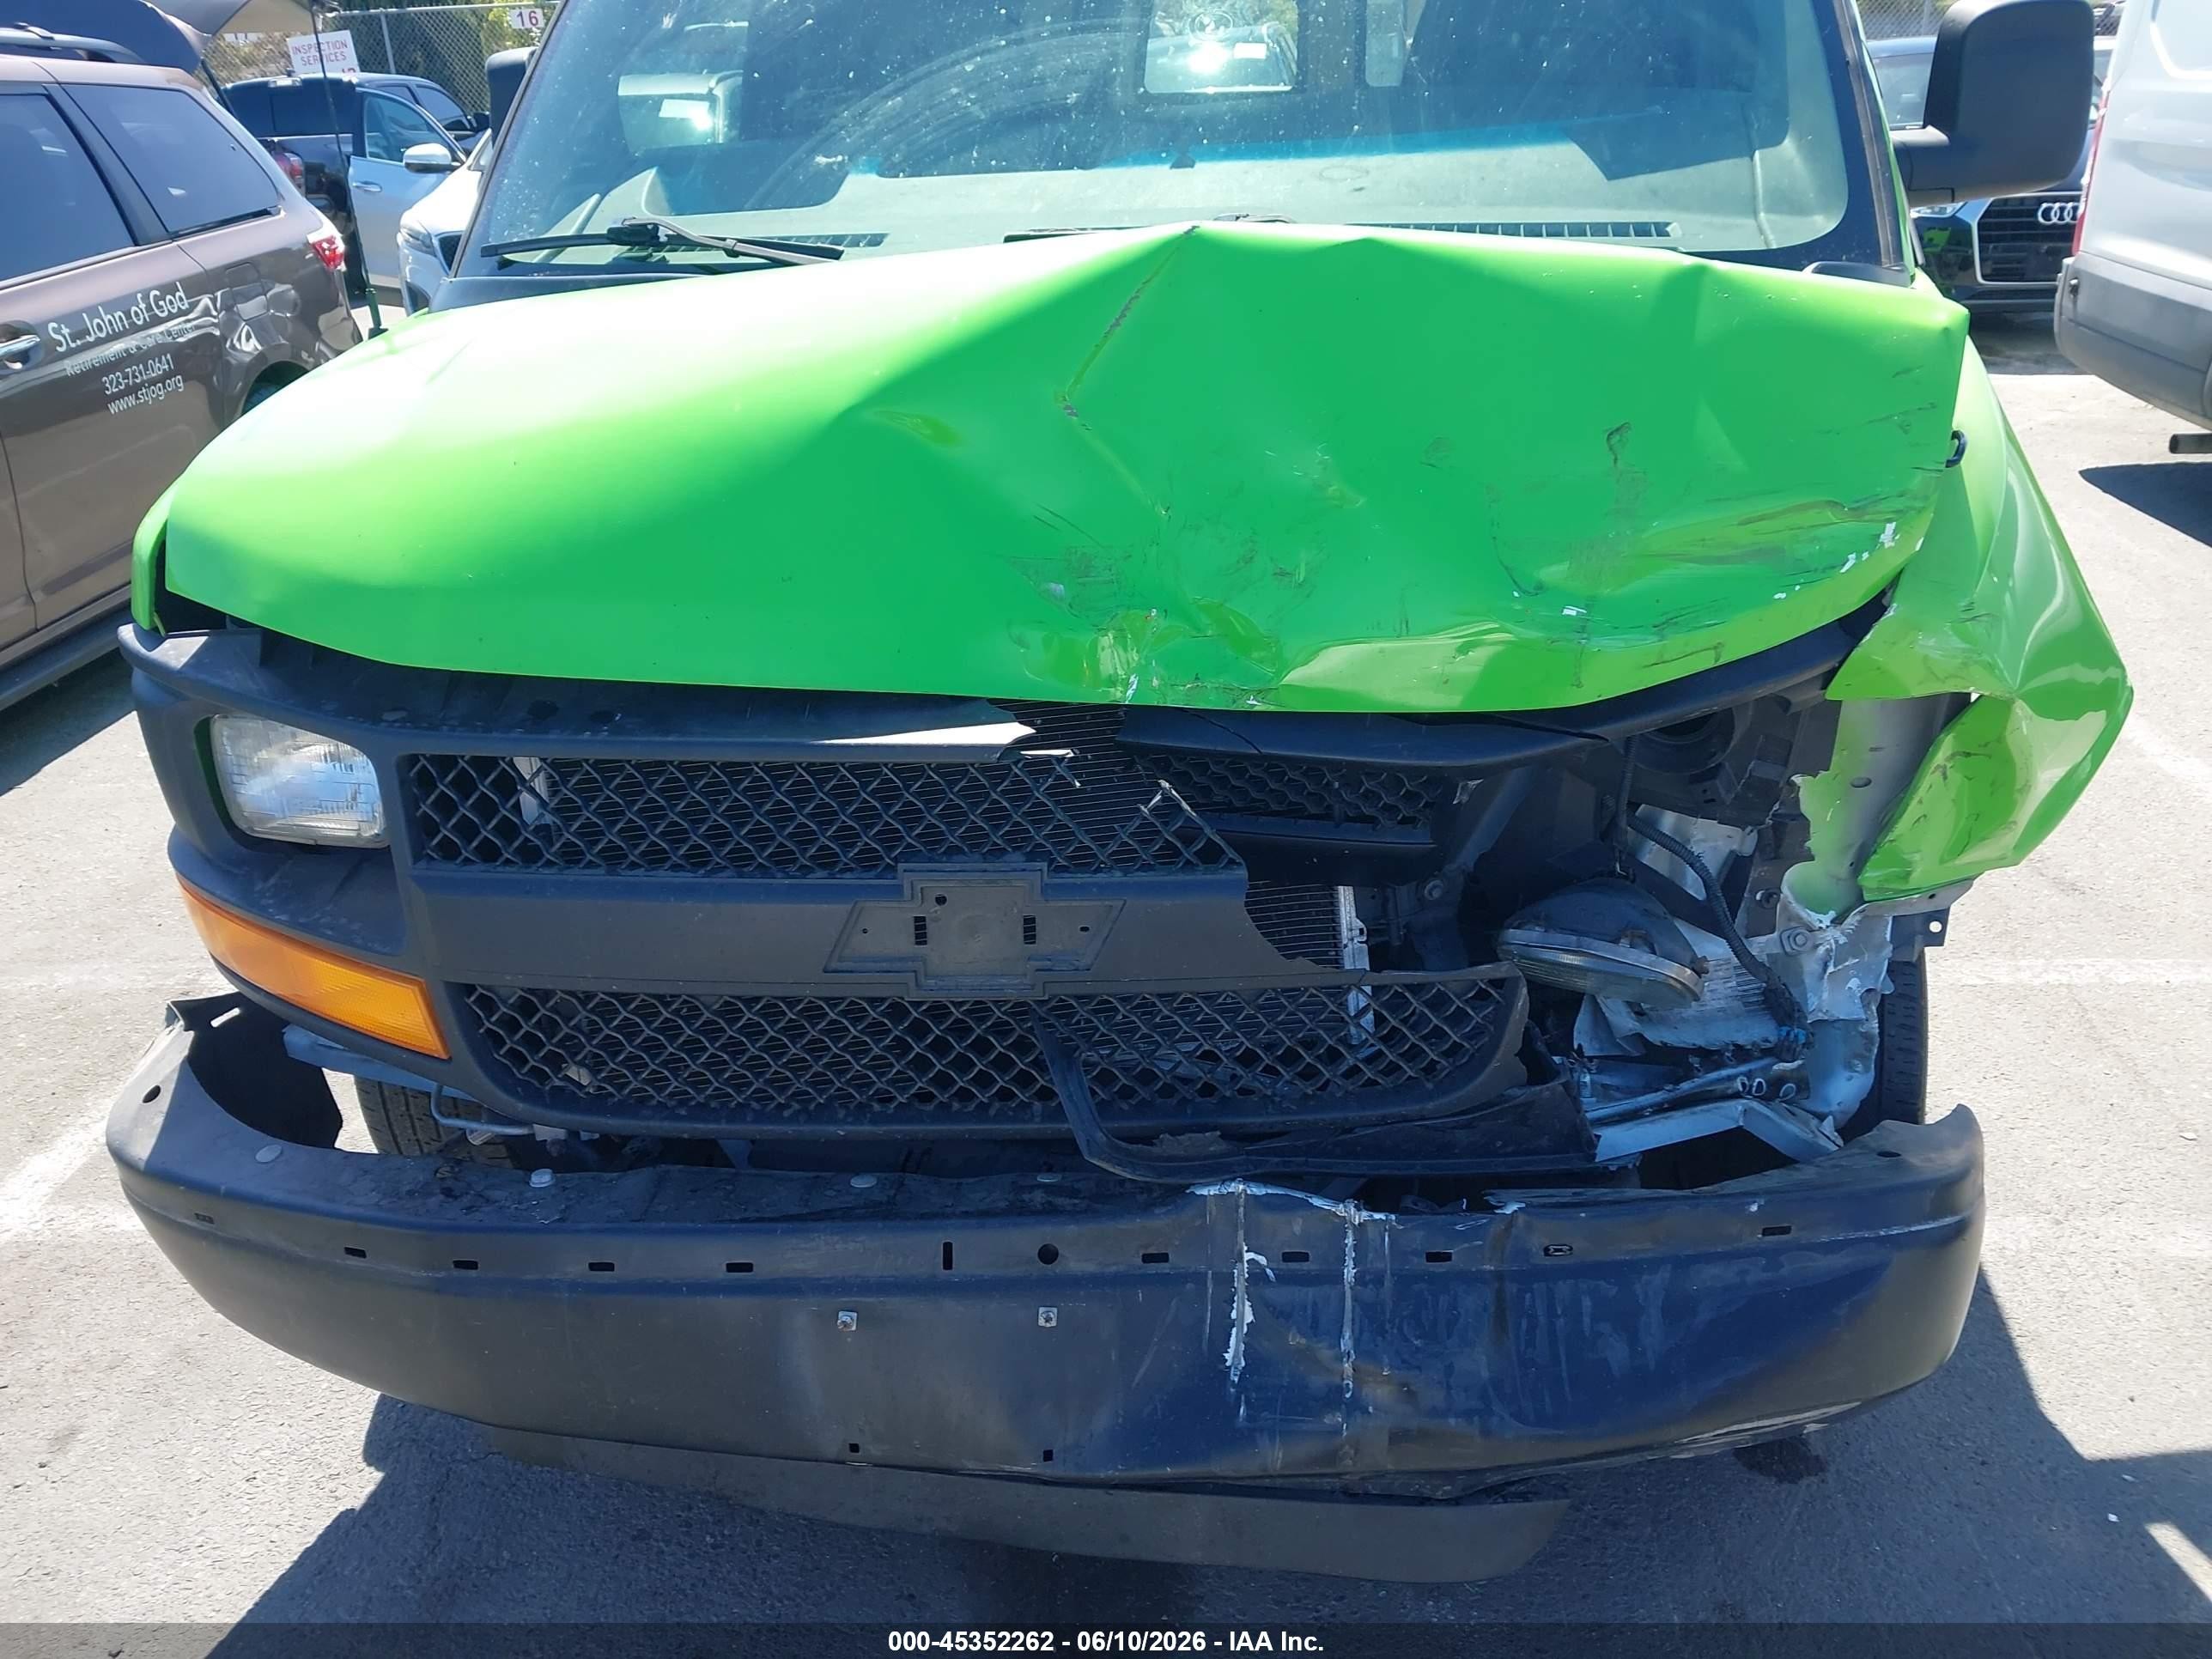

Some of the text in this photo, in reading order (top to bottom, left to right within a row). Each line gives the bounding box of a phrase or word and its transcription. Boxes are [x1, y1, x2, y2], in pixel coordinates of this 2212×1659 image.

[517, 10, 538, 27] 16
[301, 51, 347, 66] SERICES
[48, 282, 190, 353] St. John of God
[102, 353, 174, 395] 323-731-0641
[107, 374, 185, 415] www.stjog.org
